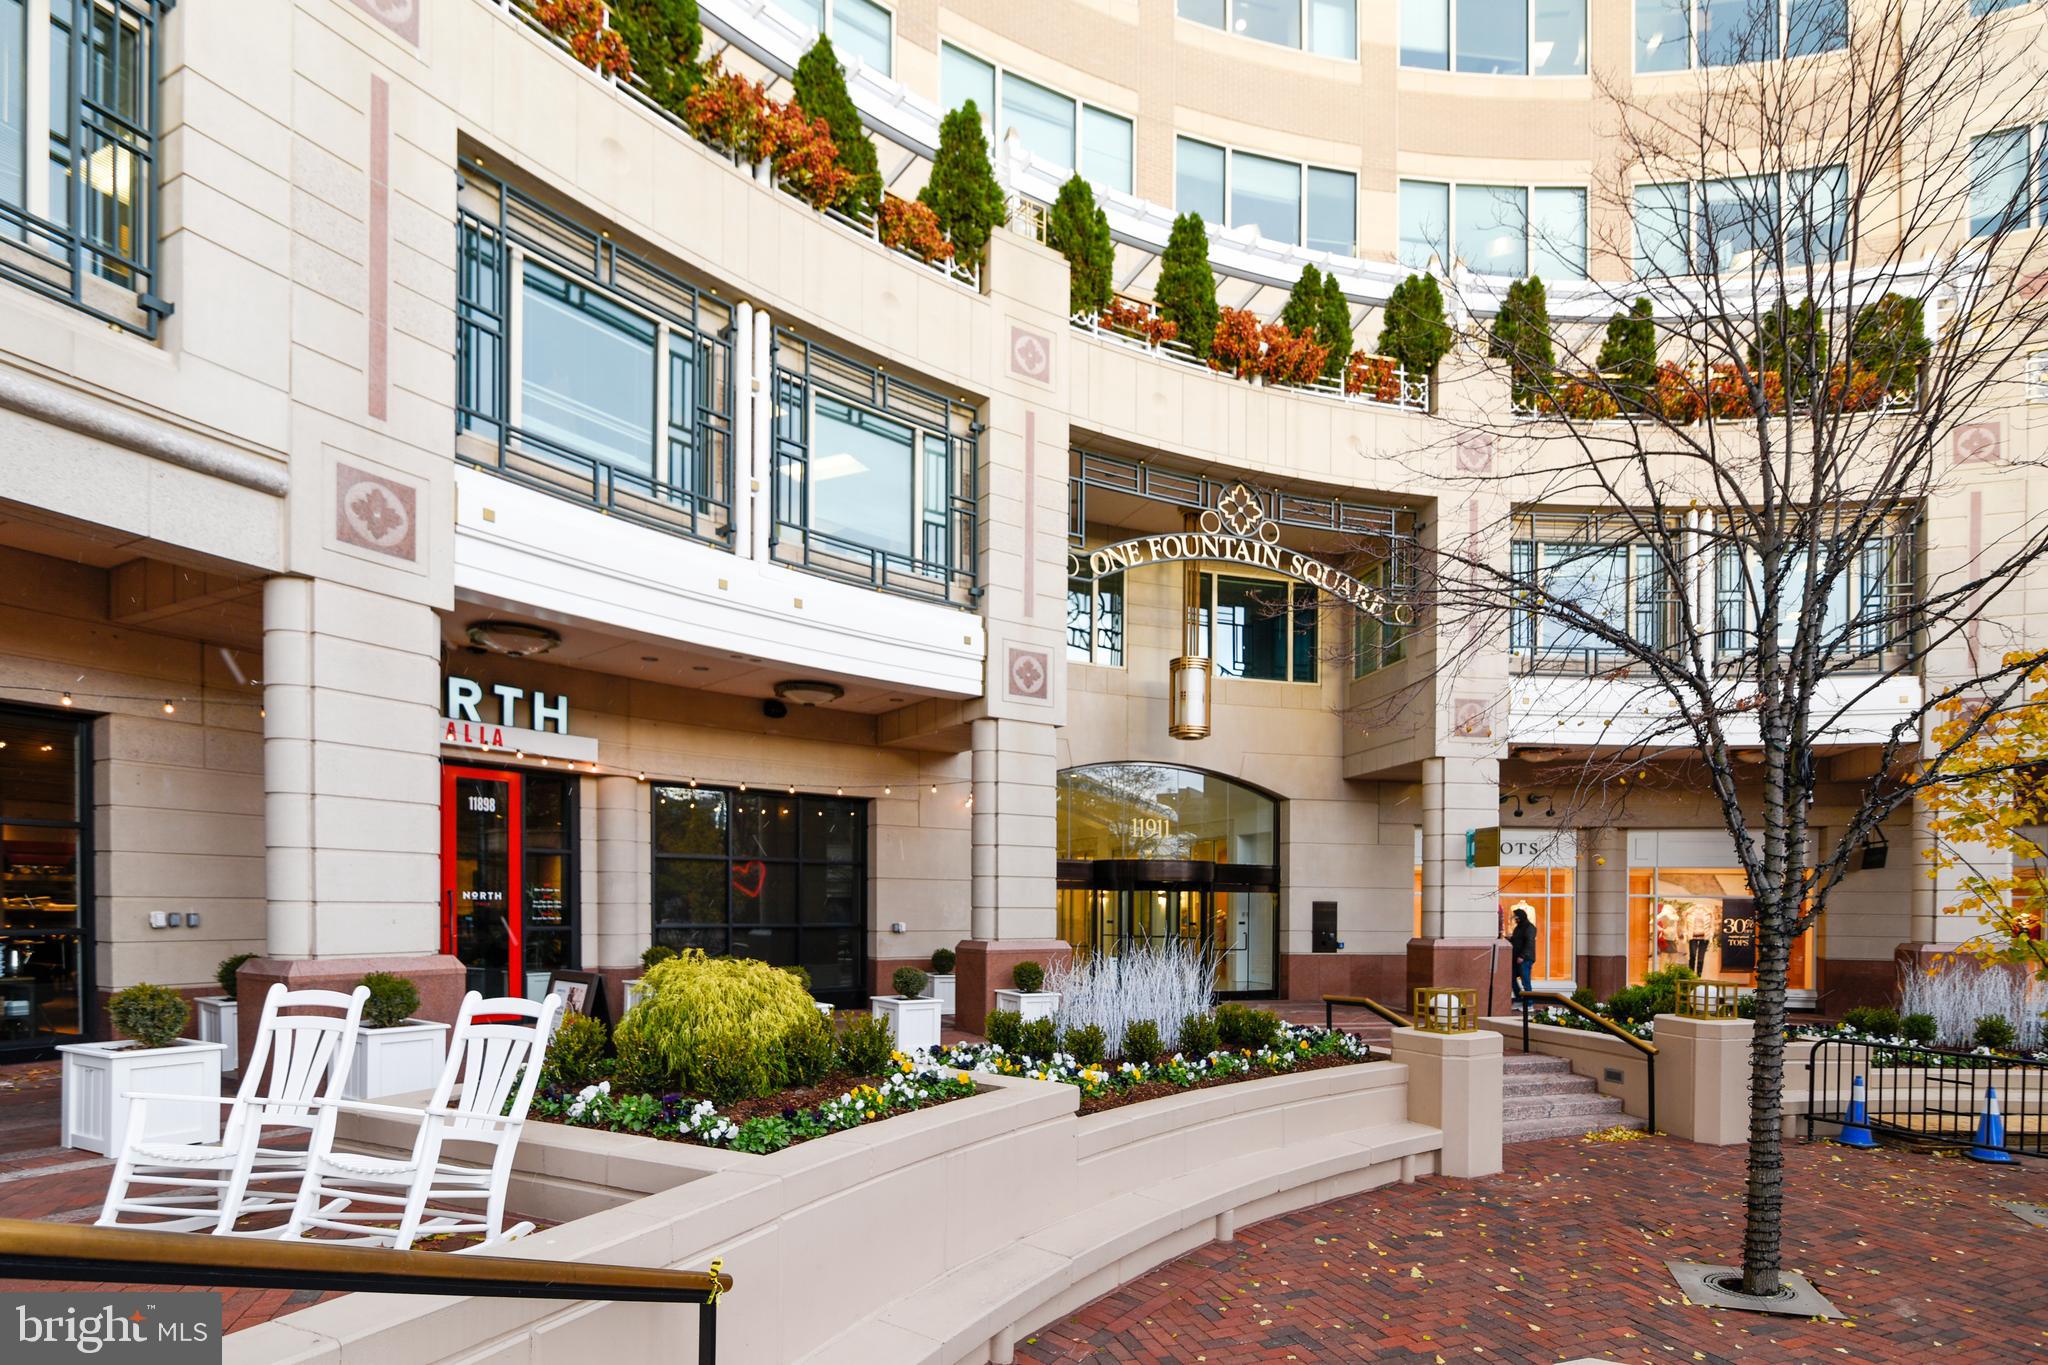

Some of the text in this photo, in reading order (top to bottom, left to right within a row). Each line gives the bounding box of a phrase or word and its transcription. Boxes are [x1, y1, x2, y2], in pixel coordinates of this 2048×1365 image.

[1090, 535, 1387, 618] ONE FOUNTAIN SQUARE
[447, 676, 568, 735] RTH
[445, 721, 504, 746] ALLA
[468, 796, 496, 812] 11898
[1131, 818, 1170, 838] 11911
[1500, 842, 1538, 855] OTS
[462, 891, 502, 900] NORTH
